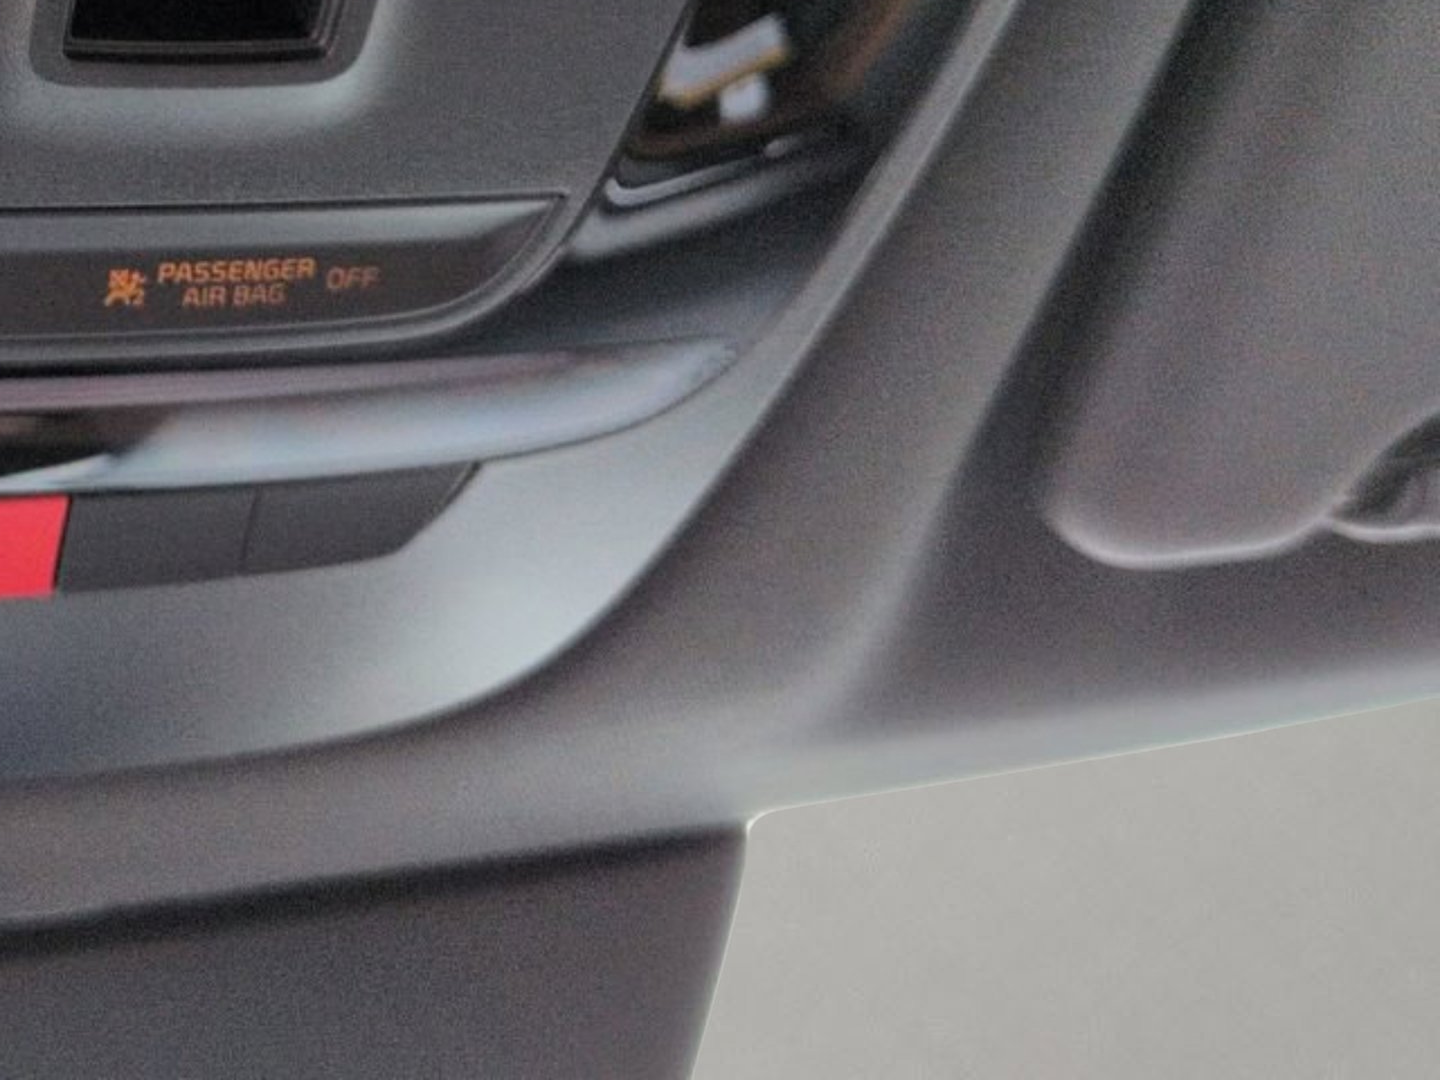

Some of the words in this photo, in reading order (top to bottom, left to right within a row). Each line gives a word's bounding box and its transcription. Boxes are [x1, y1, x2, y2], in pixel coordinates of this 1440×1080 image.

[157, 258, 316, 283] PASSENGER
[326, 266, 379, 290] OFF
[182, 286, 226, 307] AIR
[233, 283, 286, 306] BAG
